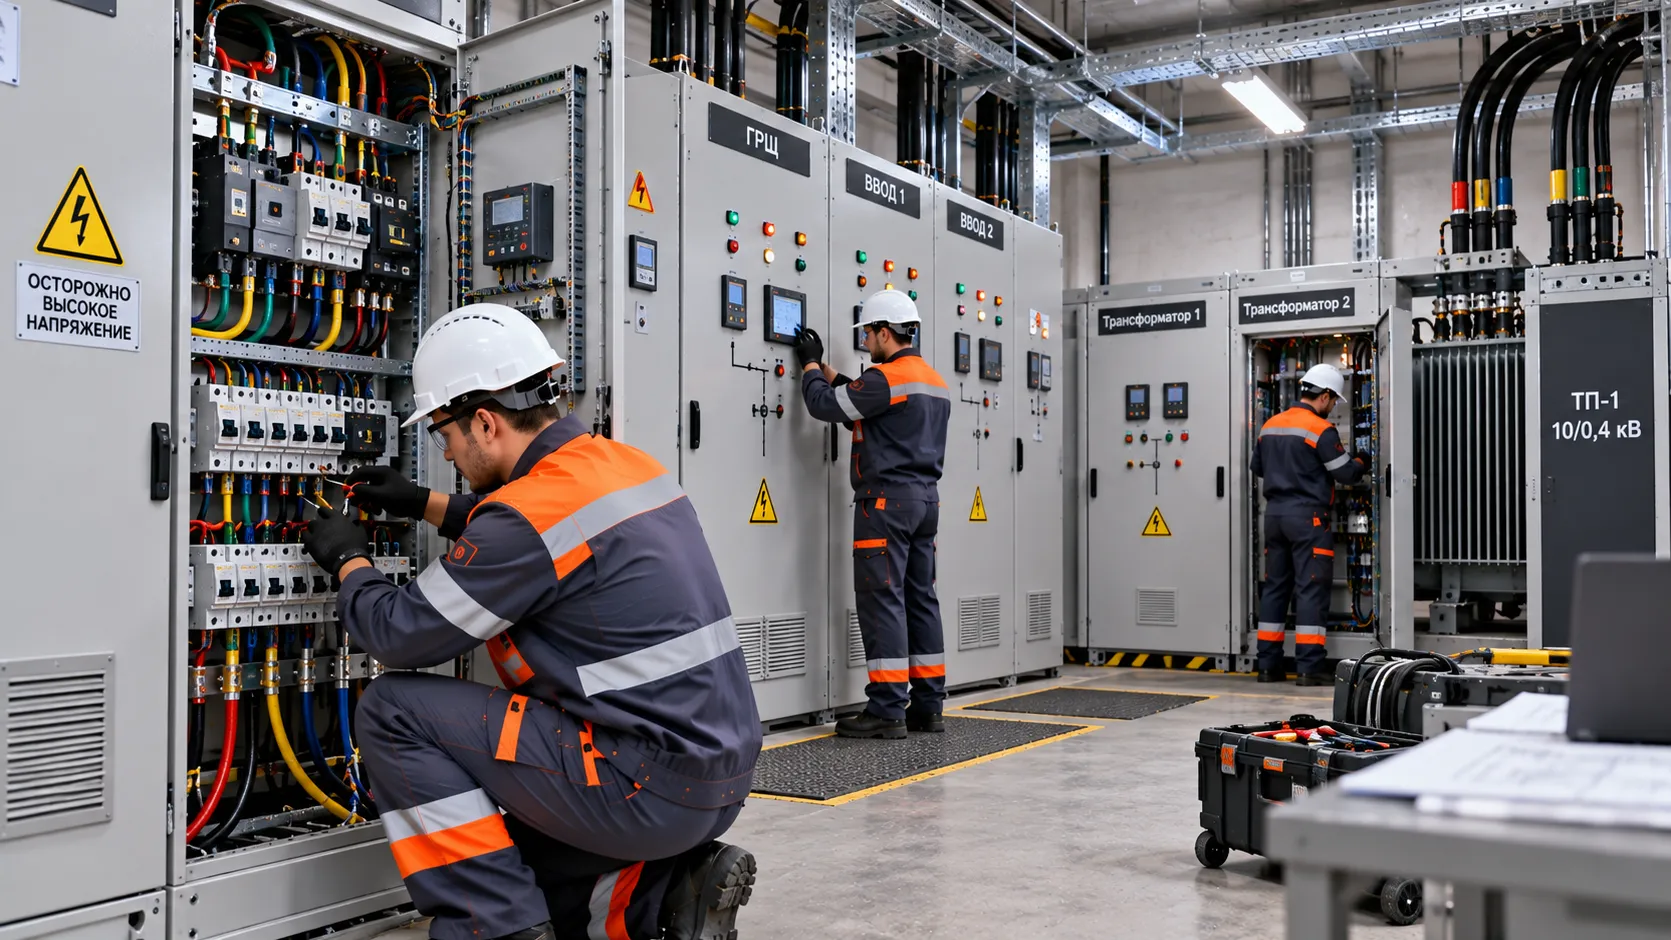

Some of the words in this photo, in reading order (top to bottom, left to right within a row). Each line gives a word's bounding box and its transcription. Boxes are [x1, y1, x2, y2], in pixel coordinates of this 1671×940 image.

[747, 126, 779, 160] ГРЩ
[865, 174, 897, 205] ВВОД
[900, 189, 905, 204] 1
[961, 212, 987, 239] ВВОД
[988, 224, 994, 239] 2
[28, 273, 131, 302] ОСТОРОЖНО
[43, 295, 118, 319] ВЫСОКОЕ
[1102, 312, 1192, 330] Трансформатор
[1194, 308, 1200, 321] 1
[1243, 299, 1340, 318] Трансформатор
[1342, 296, 1351, 309] 2
[27, 314, 132, 340] НАПРЯЖЕНИЕ
[1571, 390, 1619, 410] ТП-1
[1552, 420, 1611, 442] 10/0,4
[1616, 420, 1642, 438] кВ
